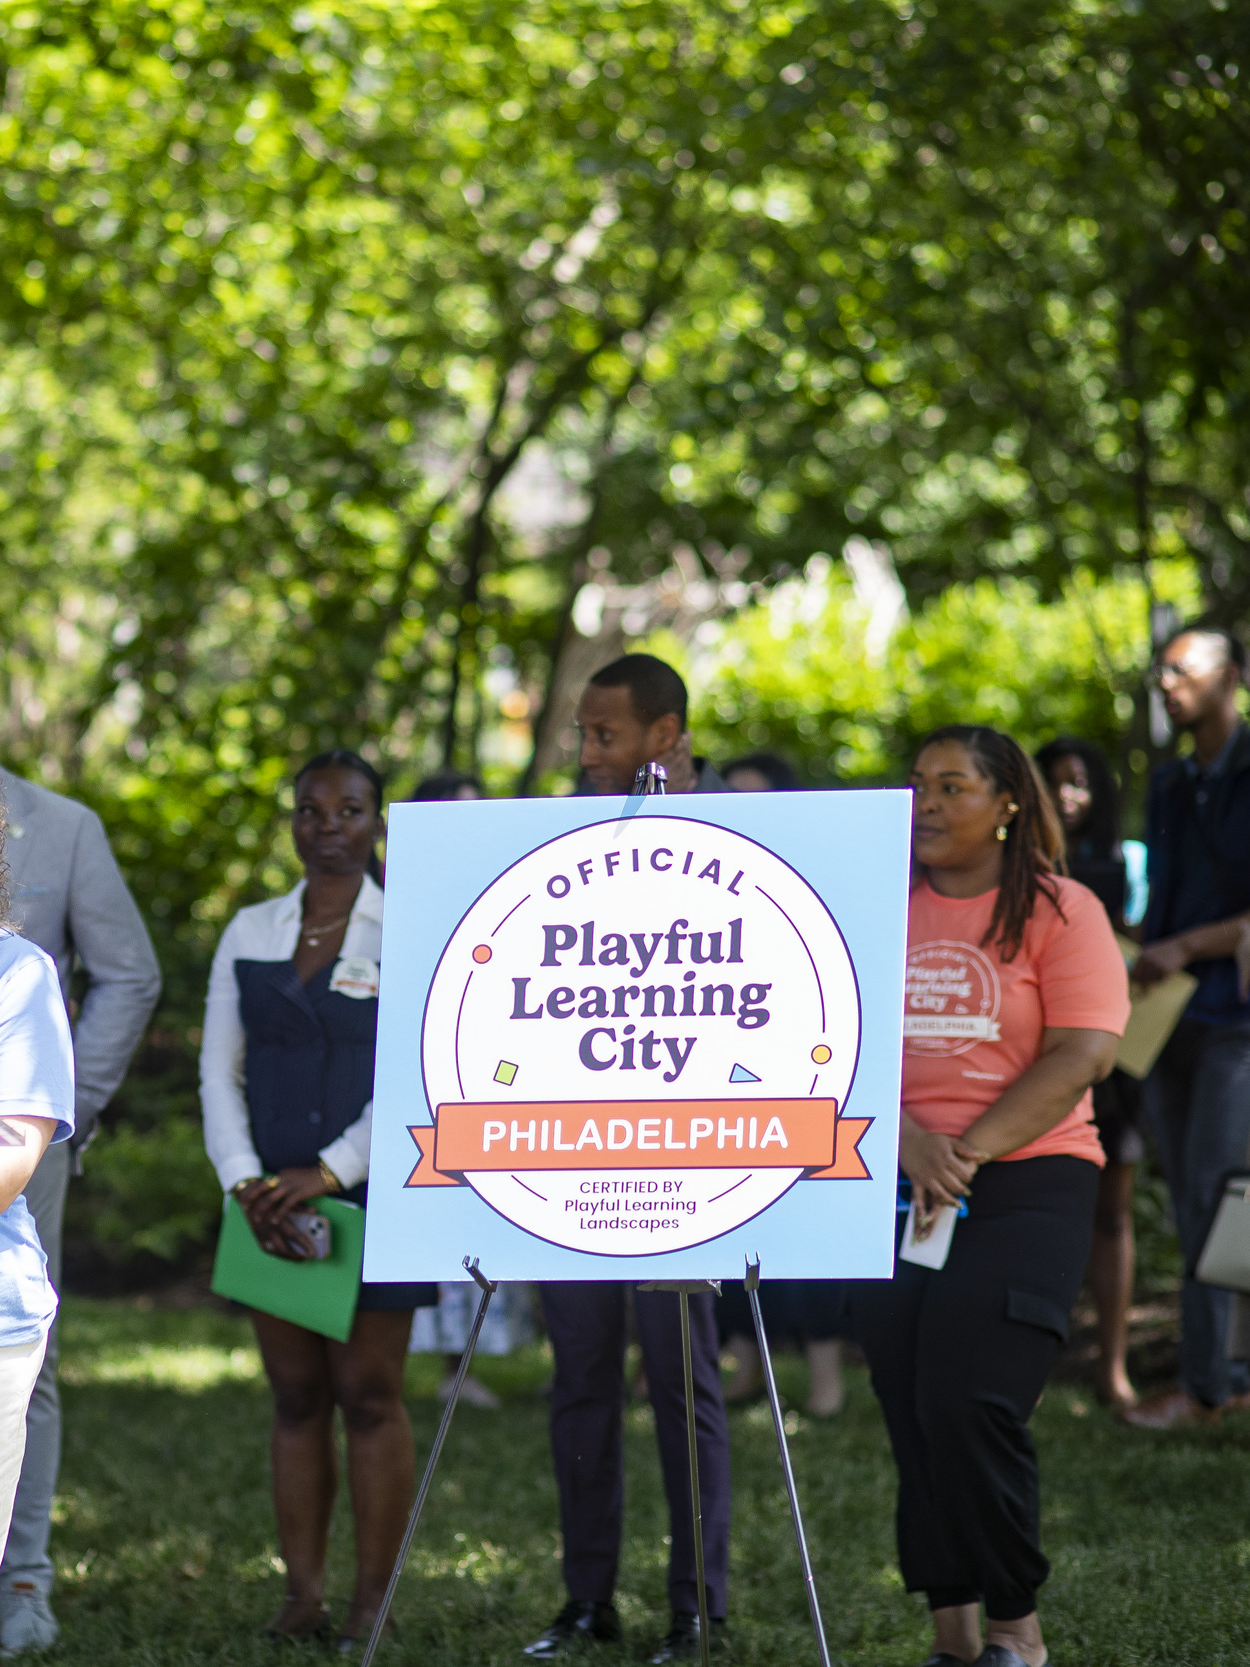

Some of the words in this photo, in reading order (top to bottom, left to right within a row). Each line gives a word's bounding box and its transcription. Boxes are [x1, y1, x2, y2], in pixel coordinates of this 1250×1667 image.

[546, 847, 745, 899] OFFICIAL
[539, 917, 744, 979] Playful
[509, 971, 773, 1030] Learning
[578, 1024, 698, 1083] City
[482, 1116, 789, 1152] PHILADELPHIA
[564, 1198, 620, 1216] Playful
[624, 1197, 697, 1215] Learning
[579, 1181, 658, 1194] CERTIFIED
[662, 1180, 684, 1193] BY
[580, 1216, 680, 1233] Landscapes
